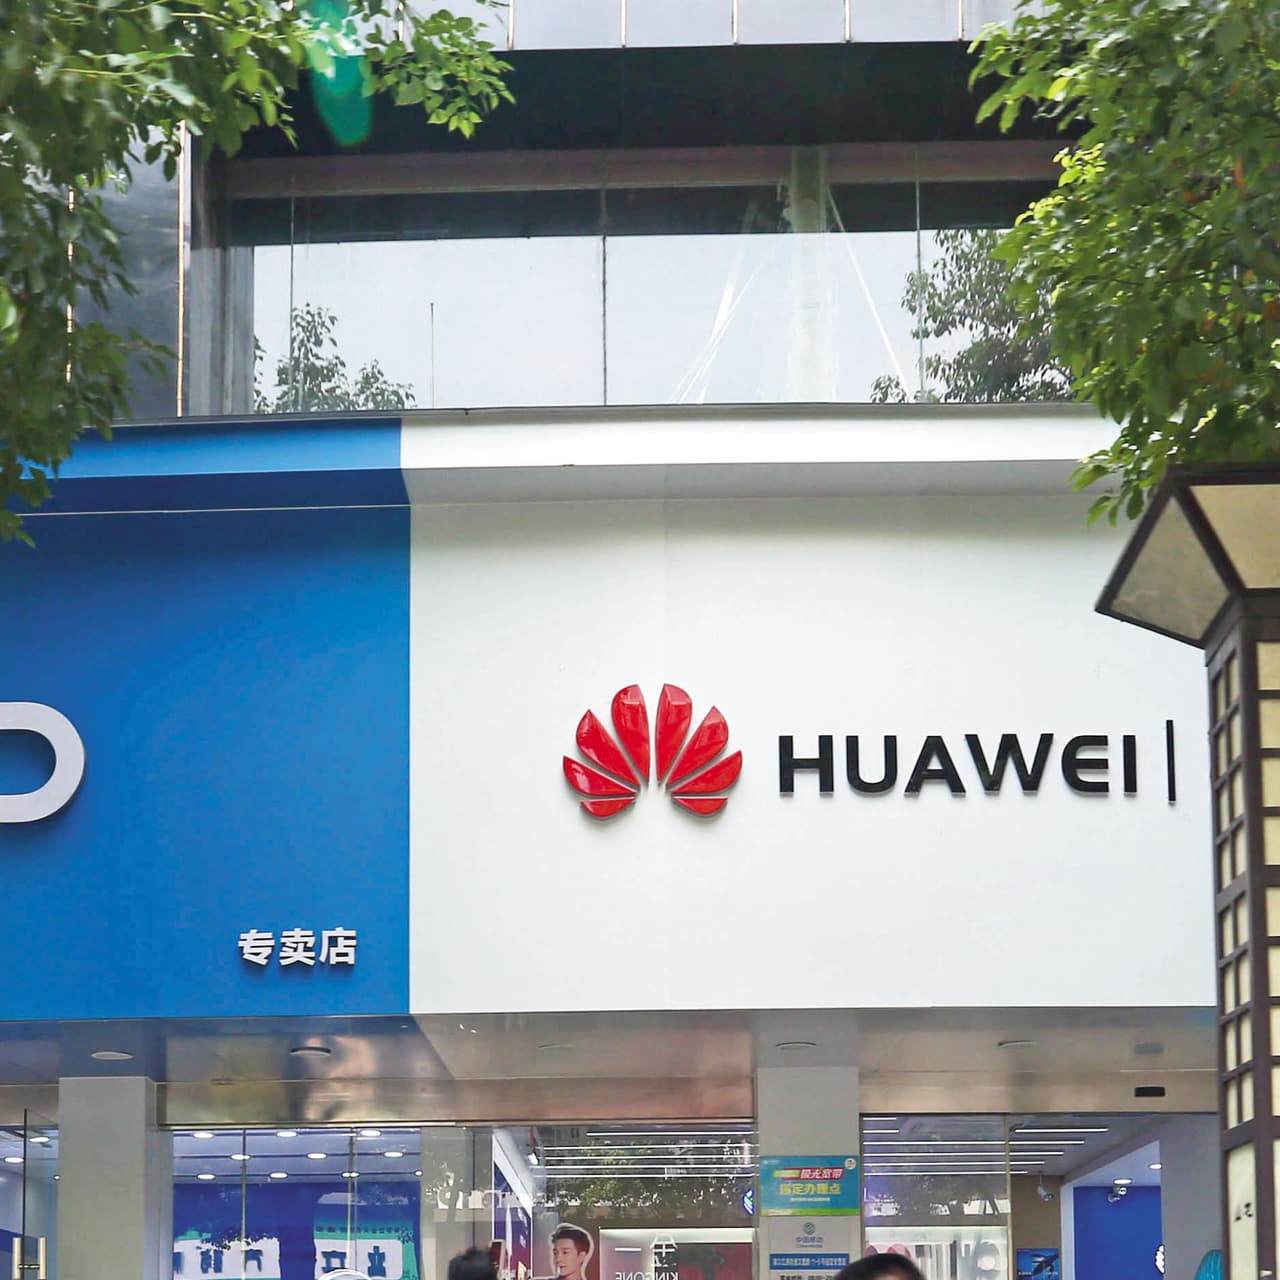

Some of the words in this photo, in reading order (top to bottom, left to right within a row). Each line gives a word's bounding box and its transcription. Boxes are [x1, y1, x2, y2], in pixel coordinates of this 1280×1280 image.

[778, 733, 1140, 797] HUAWEI
[238, 927, 359, 966] 专卖店
